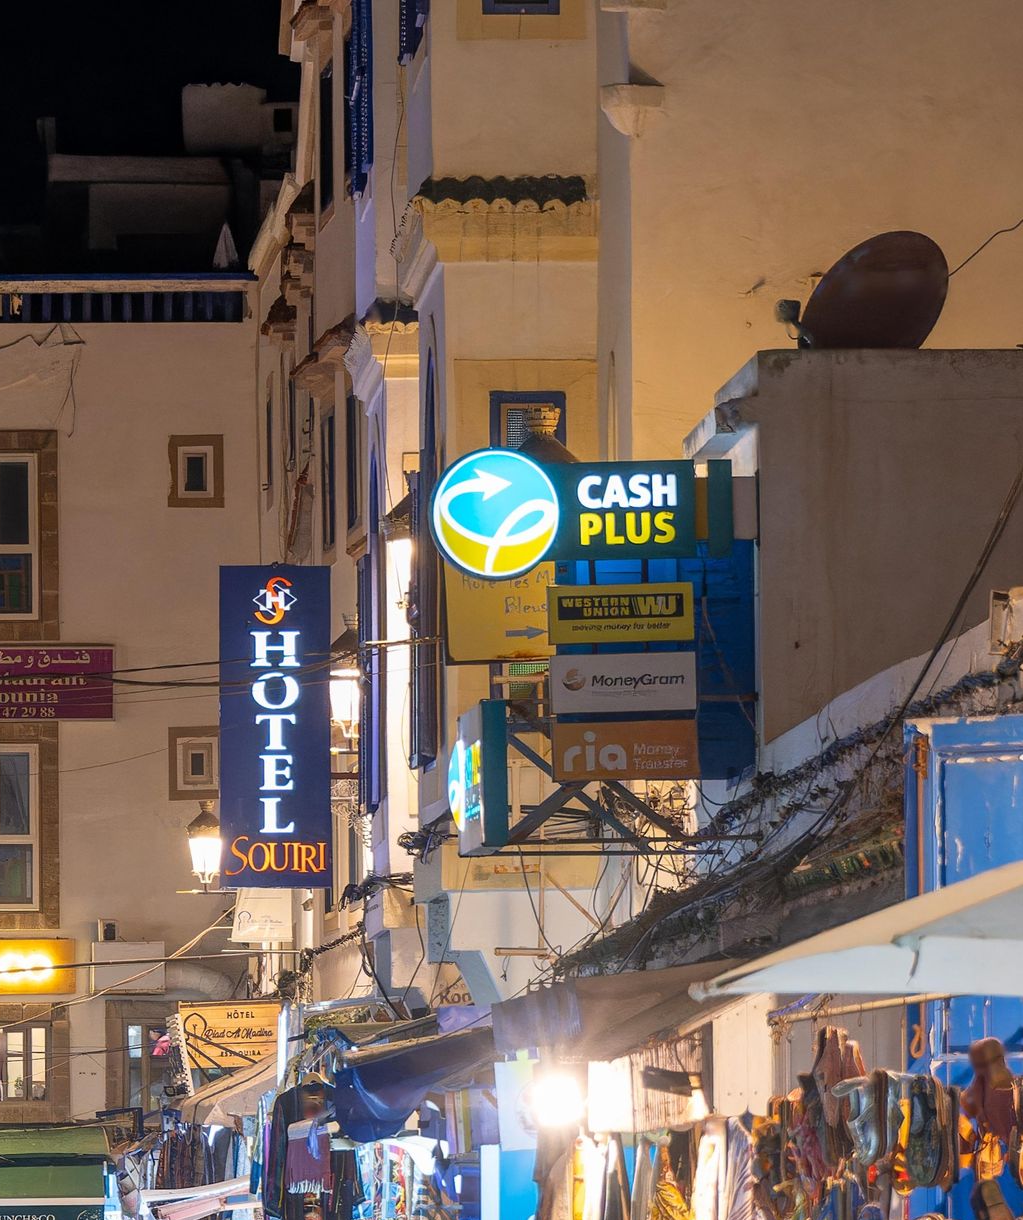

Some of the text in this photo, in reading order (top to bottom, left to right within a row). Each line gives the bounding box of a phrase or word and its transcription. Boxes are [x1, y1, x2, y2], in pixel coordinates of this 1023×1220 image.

[577, 474, 677, 509] CASH
[580, 511, 676, 546] PLUS
[561, 597, 629, 608] WESTERN
[583, 607, 629, 617] UNION
[591, 673, 685, 689] MoneyGram
[21, 707, 36, 718] 29
[40, 707, 56, 718] 88
[250, 631, 301, 833] HOTEL
[563, 731, 628, 772] ria
[226, 1009, 255, 1019] HÔTEL
